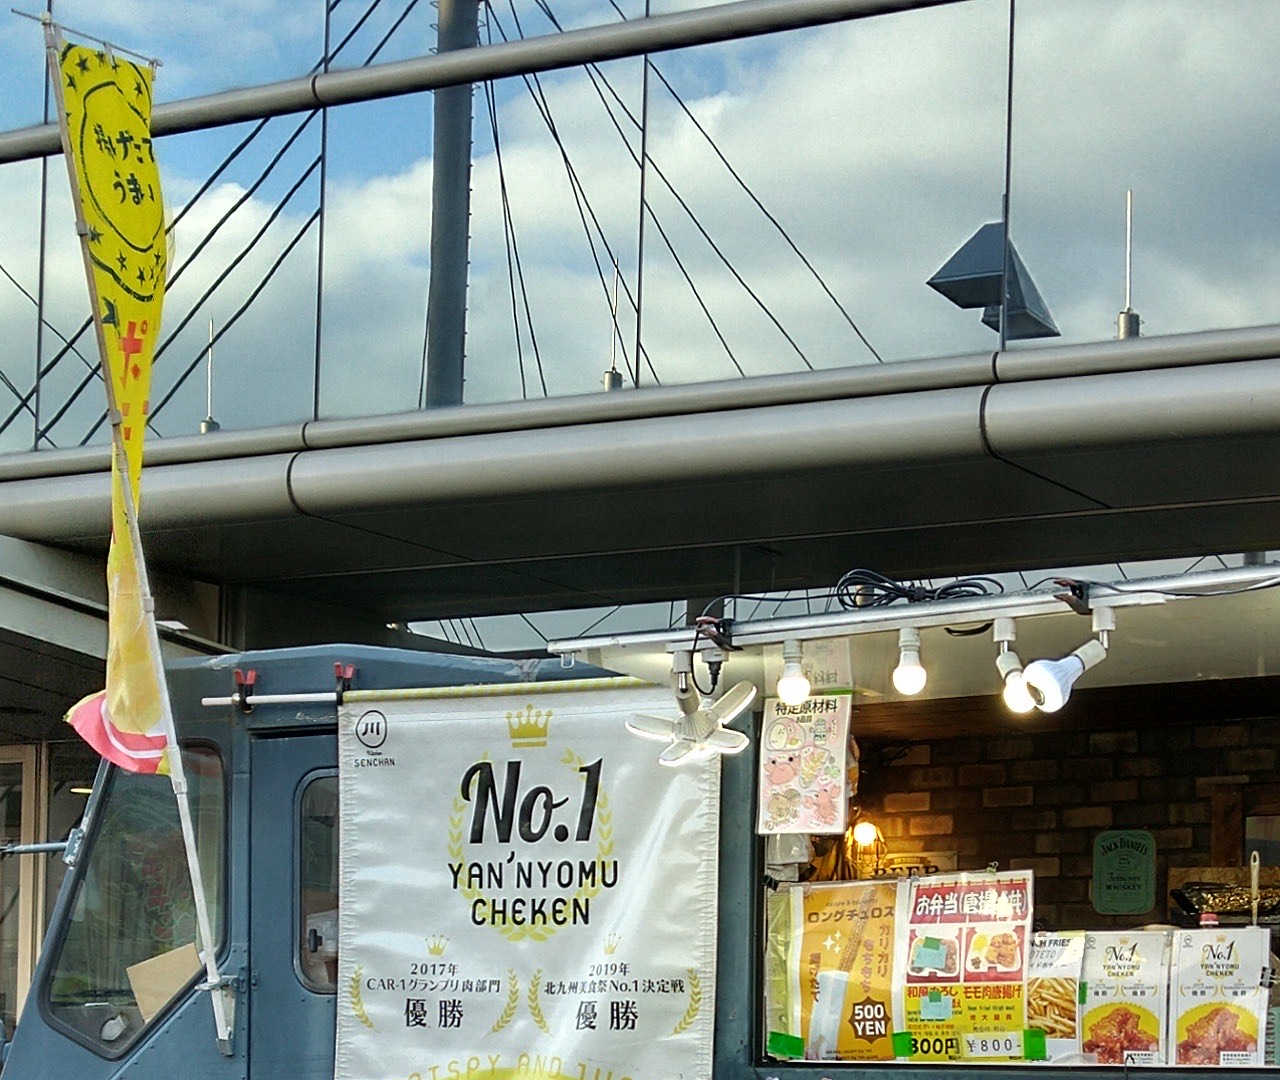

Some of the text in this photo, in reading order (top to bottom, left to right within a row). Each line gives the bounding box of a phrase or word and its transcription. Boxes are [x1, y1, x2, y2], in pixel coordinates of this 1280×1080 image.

[354, 758, 396, 768] SENCHAN
[460, 757, 604, 845] No.1
[448, 851, 619, 889] YAN'NYOMU
[471, 898, 590, 926] CHEKEN
[808, 906, 895, 923] ロングチュロス
[410, 962, 459, 977] 2017年
[589, 962, 630, 977] 2019年
[855, 1004, 884, 1020] 500
[855, 1021, 886, 1036] YEN
[517, 1053, 562, 1078] AND
